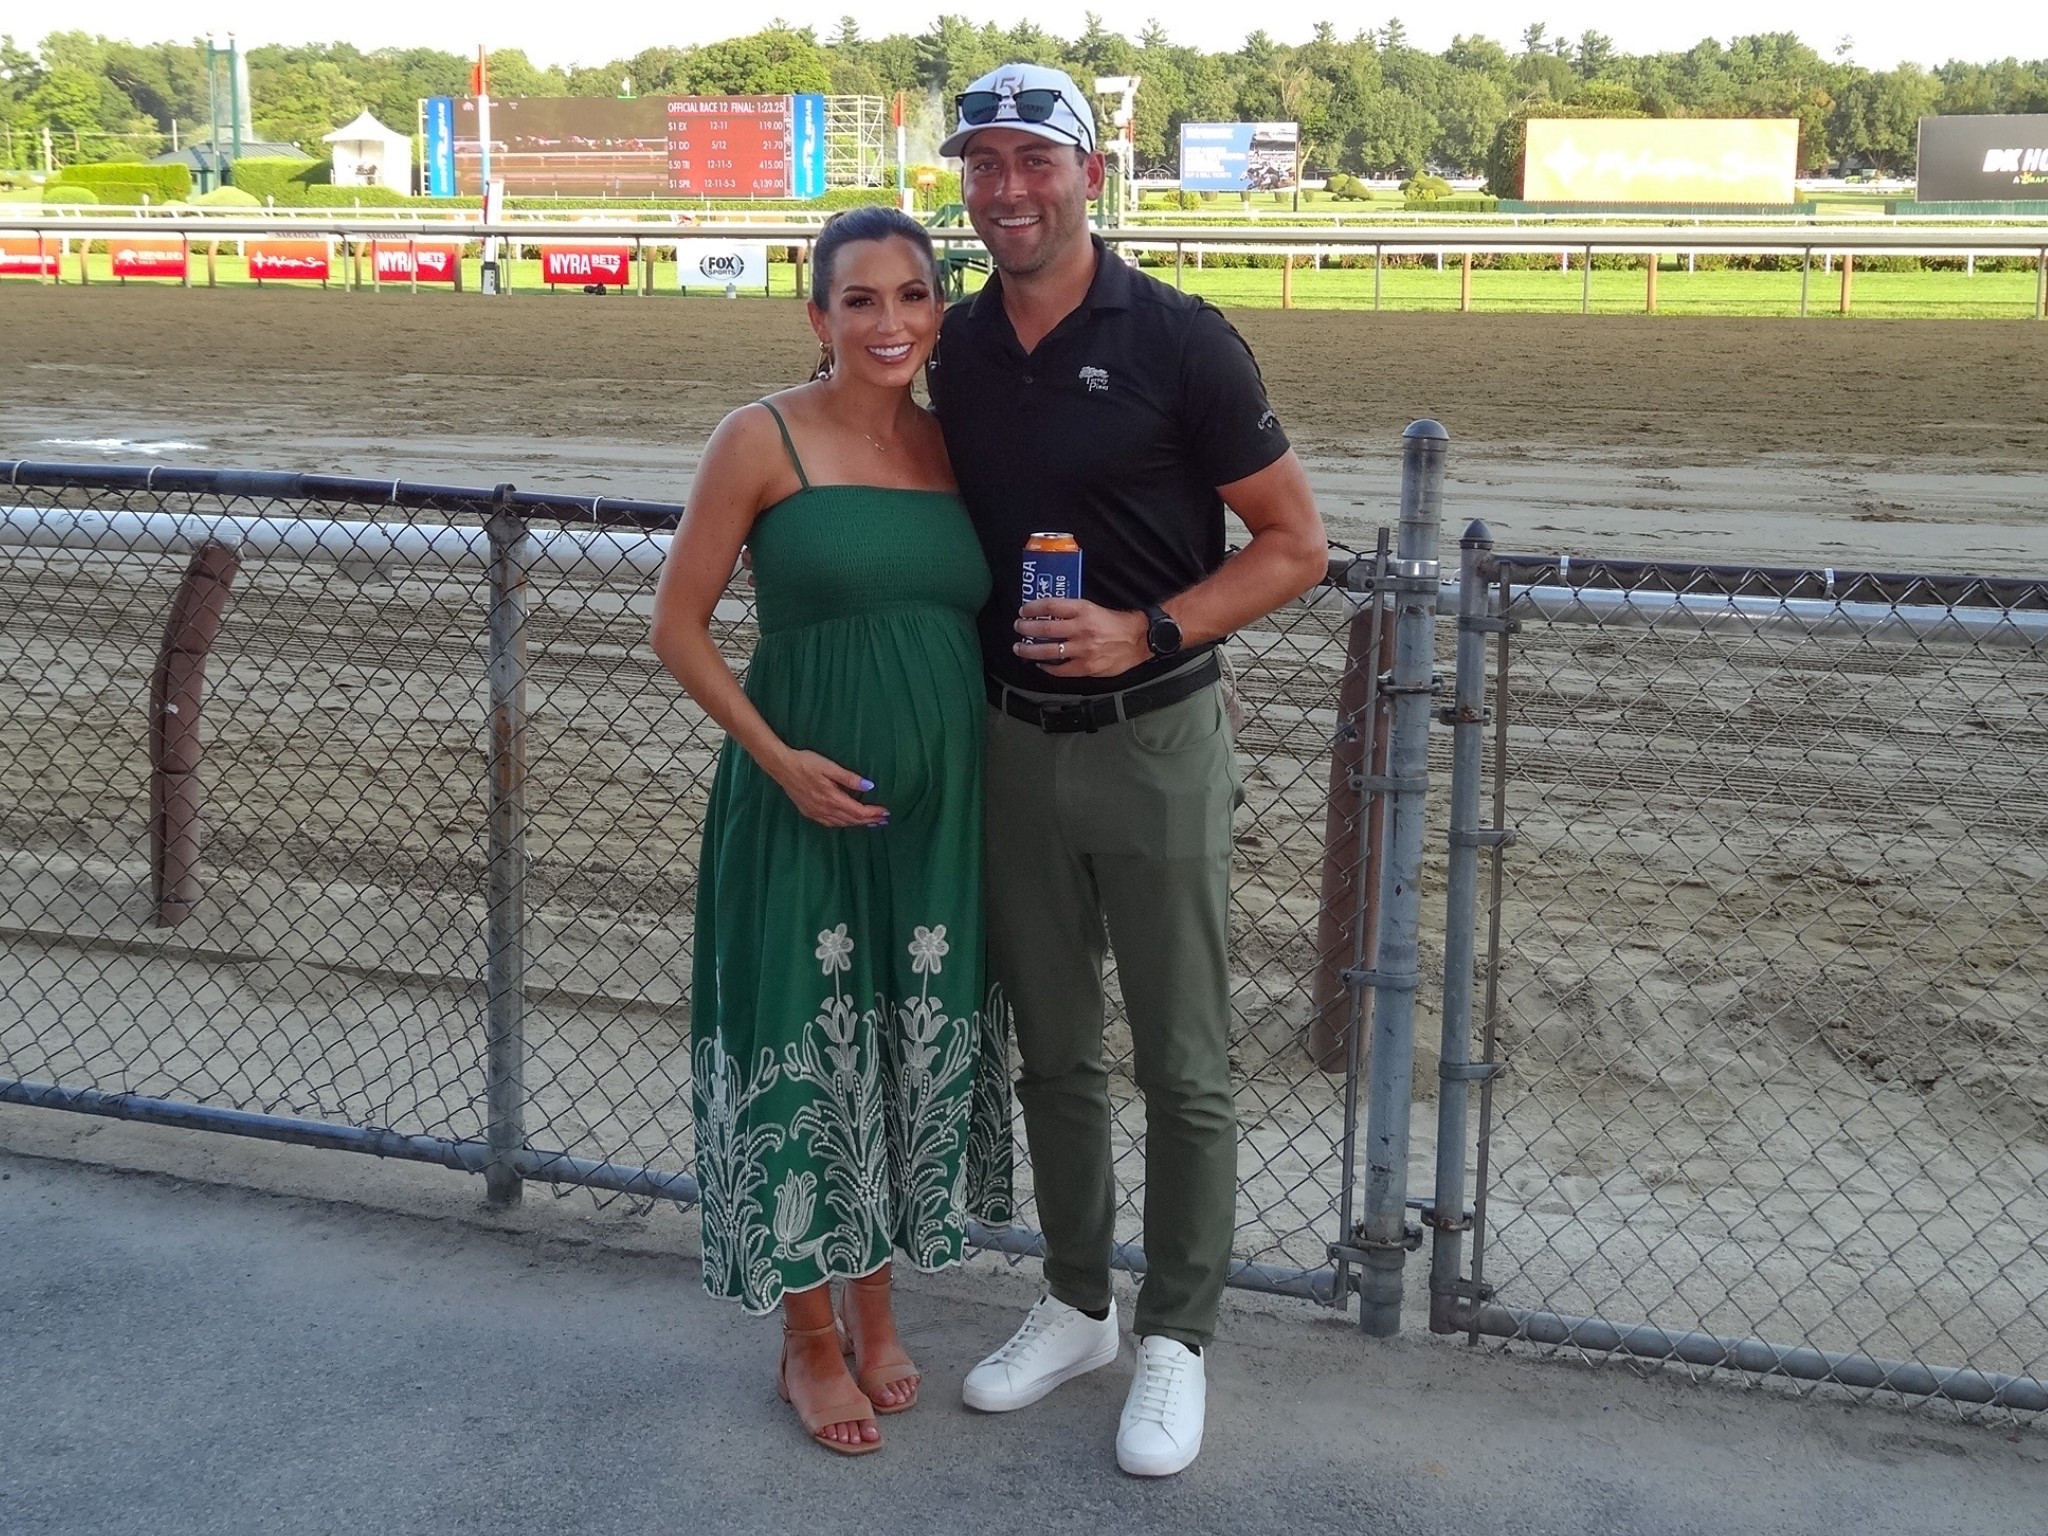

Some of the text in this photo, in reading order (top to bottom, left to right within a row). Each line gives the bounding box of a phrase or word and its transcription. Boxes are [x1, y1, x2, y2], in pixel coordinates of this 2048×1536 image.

[667, 102, 784, 113] OFFICIAL RACE 12 FINAL: 1:23.25
[678, 122, 688, 131] EX
[709, 121, 728, 130] 12-11
[759, 121, 783, 130] 119.00
[711, 140, 727, 150] 5/12
[763, 140, 783, 150] 21.70
[707, 159, 732, 169] 12-11-5
[759, 160, 783, 169] 415.00
[704, 178, 735, 188] 12-11-5-3
[753, 179, 783, 189] 6,139.00
[549, 253, 621, 275] NYRA BETS
[708, 256, 735, 270] FOX
[1055, 575, 1066, 599] CING
